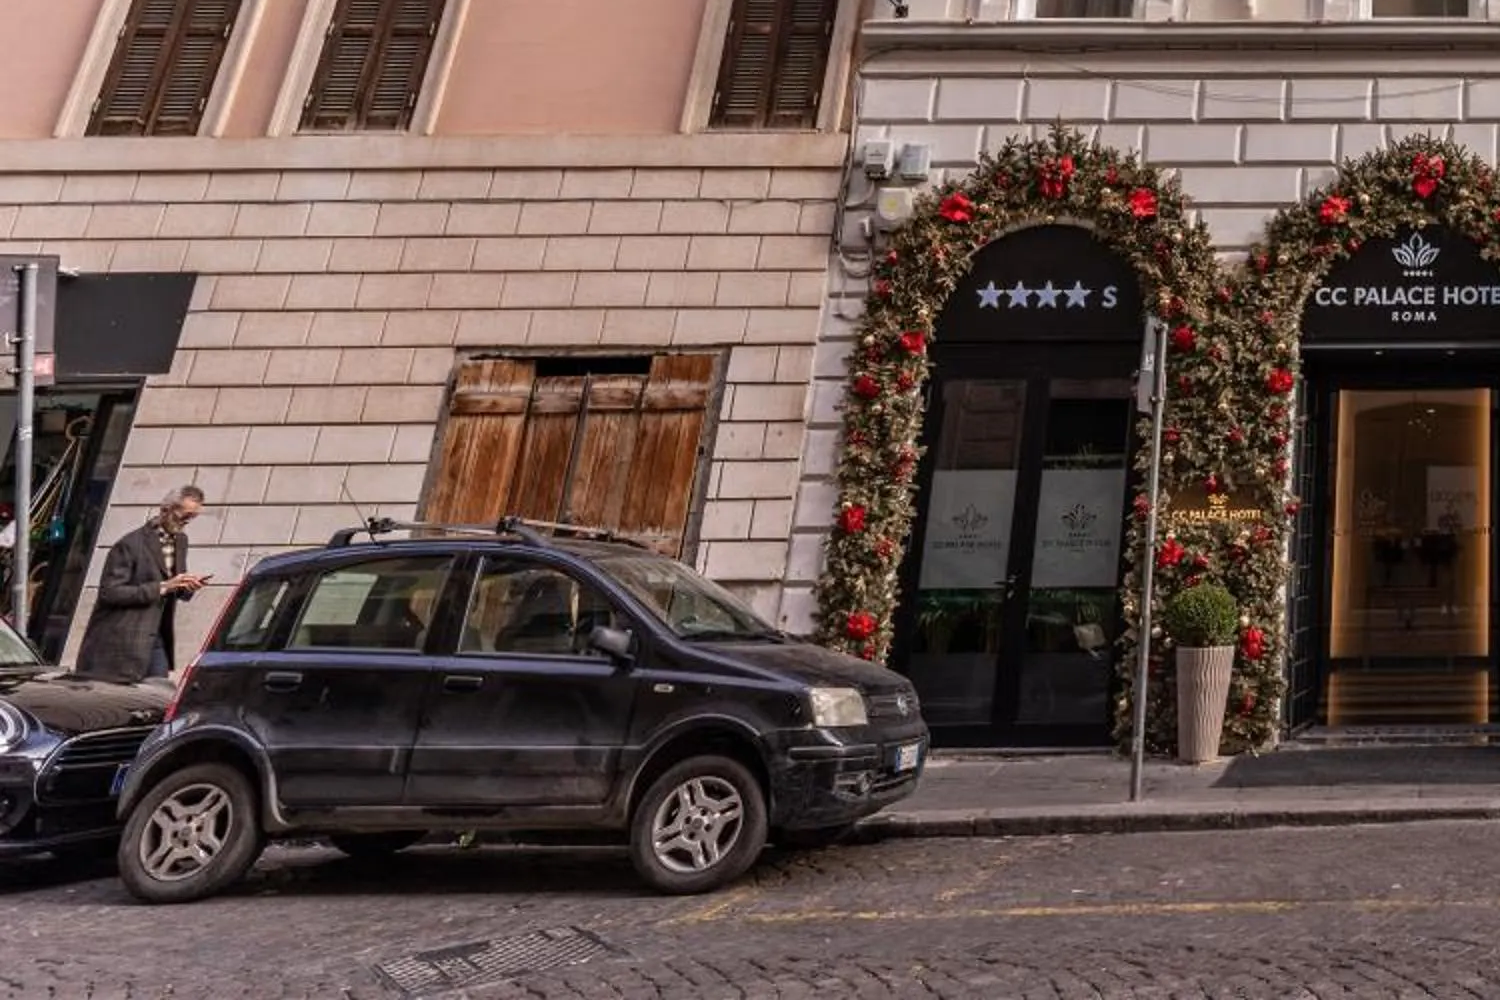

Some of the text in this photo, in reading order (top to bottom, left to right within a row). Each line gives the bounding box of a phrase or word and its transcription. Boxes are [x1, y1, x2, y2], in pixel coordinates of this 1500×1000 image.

[1101, 285, 1118, 309] S
[1315, 286, 1347, 306] CC
[1354, 286, 1436, 306] PALACE
[1391, 311, 1437, 322] ROMA
